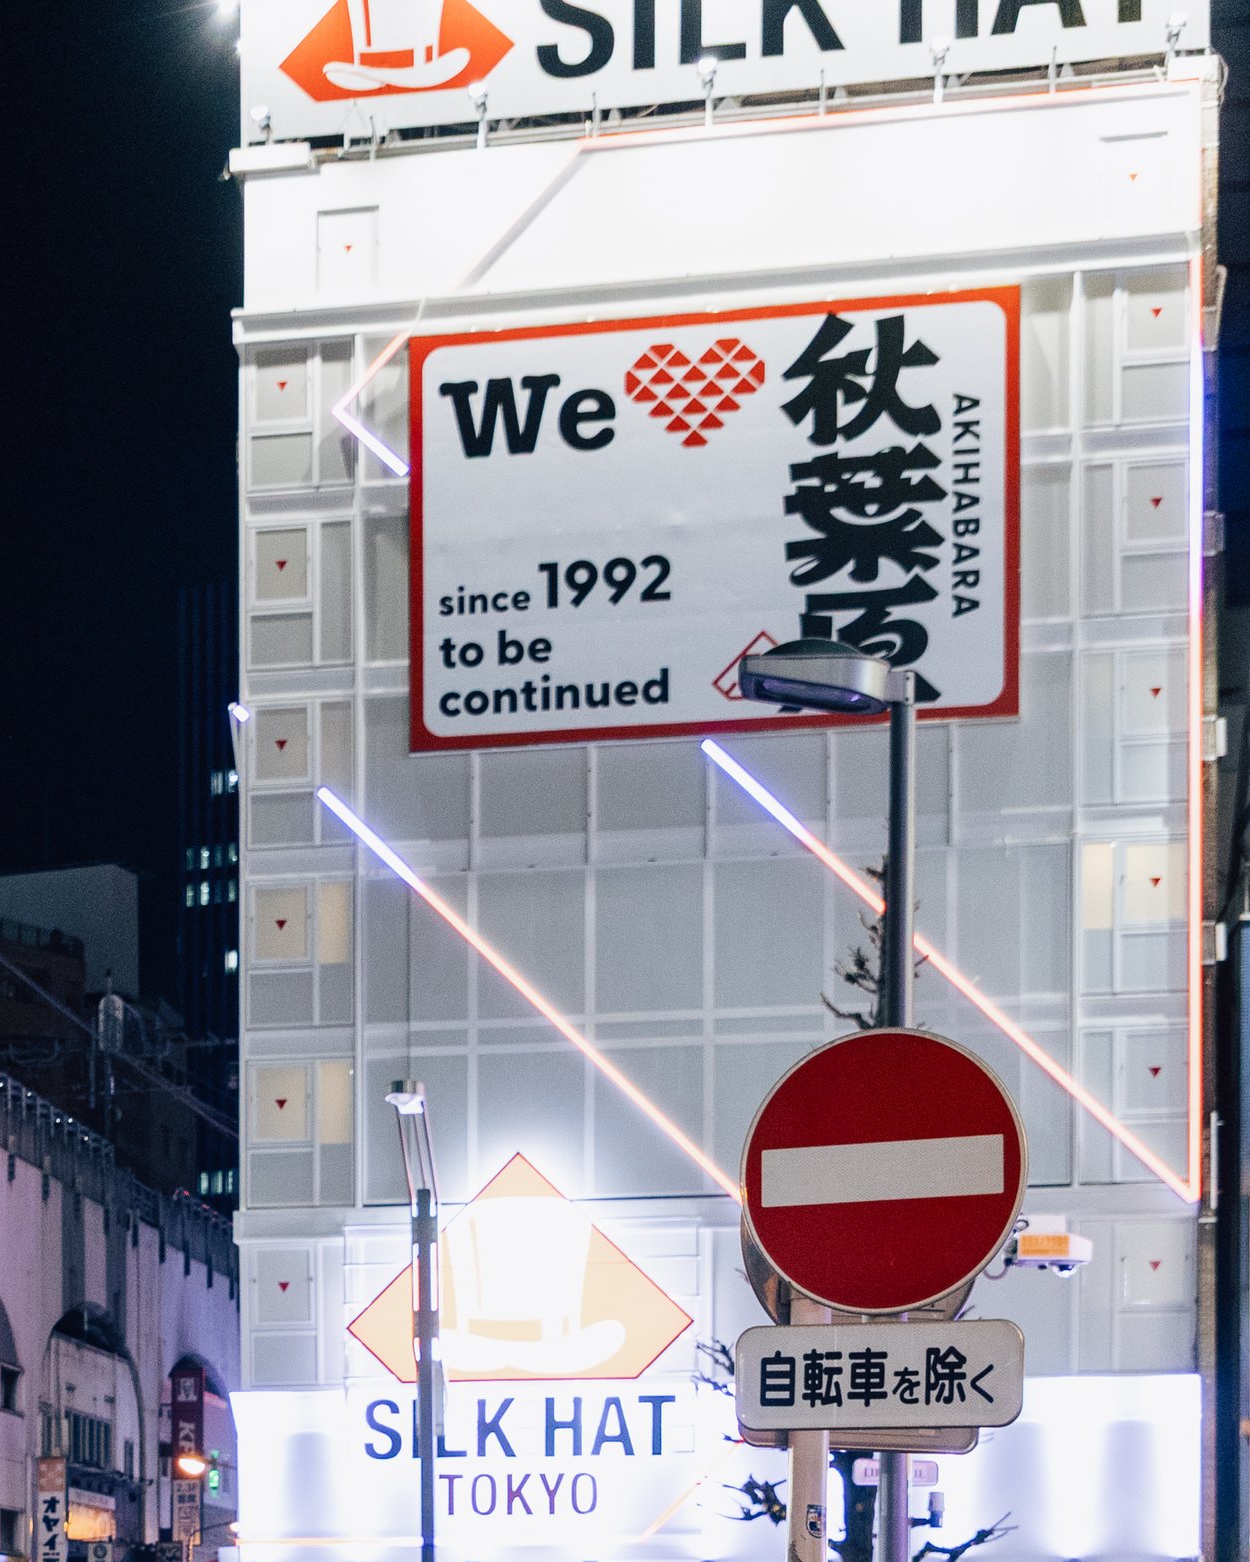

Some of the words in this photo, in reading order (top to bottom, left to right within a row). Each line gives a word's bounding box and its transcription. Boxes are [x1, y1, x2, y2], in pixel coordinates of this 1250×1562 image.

[439, 372, 617, 459] We
[952, 392, 981, 619] AKIHABARA
[439, 586, 531, 617] since
[538, 554, 672, 610] 1992
[440, 636, 484, 670] to
[497, 629, 553, 666] be
[439, 667, 671, 717] continued
[760, 1346, 994, 1408] 自転車を除く
[365, 1397, 517, 1460] SILK
[545, 1394, 676, 1457] HAT
[440, 1473, 599, 1516] TOKYO
